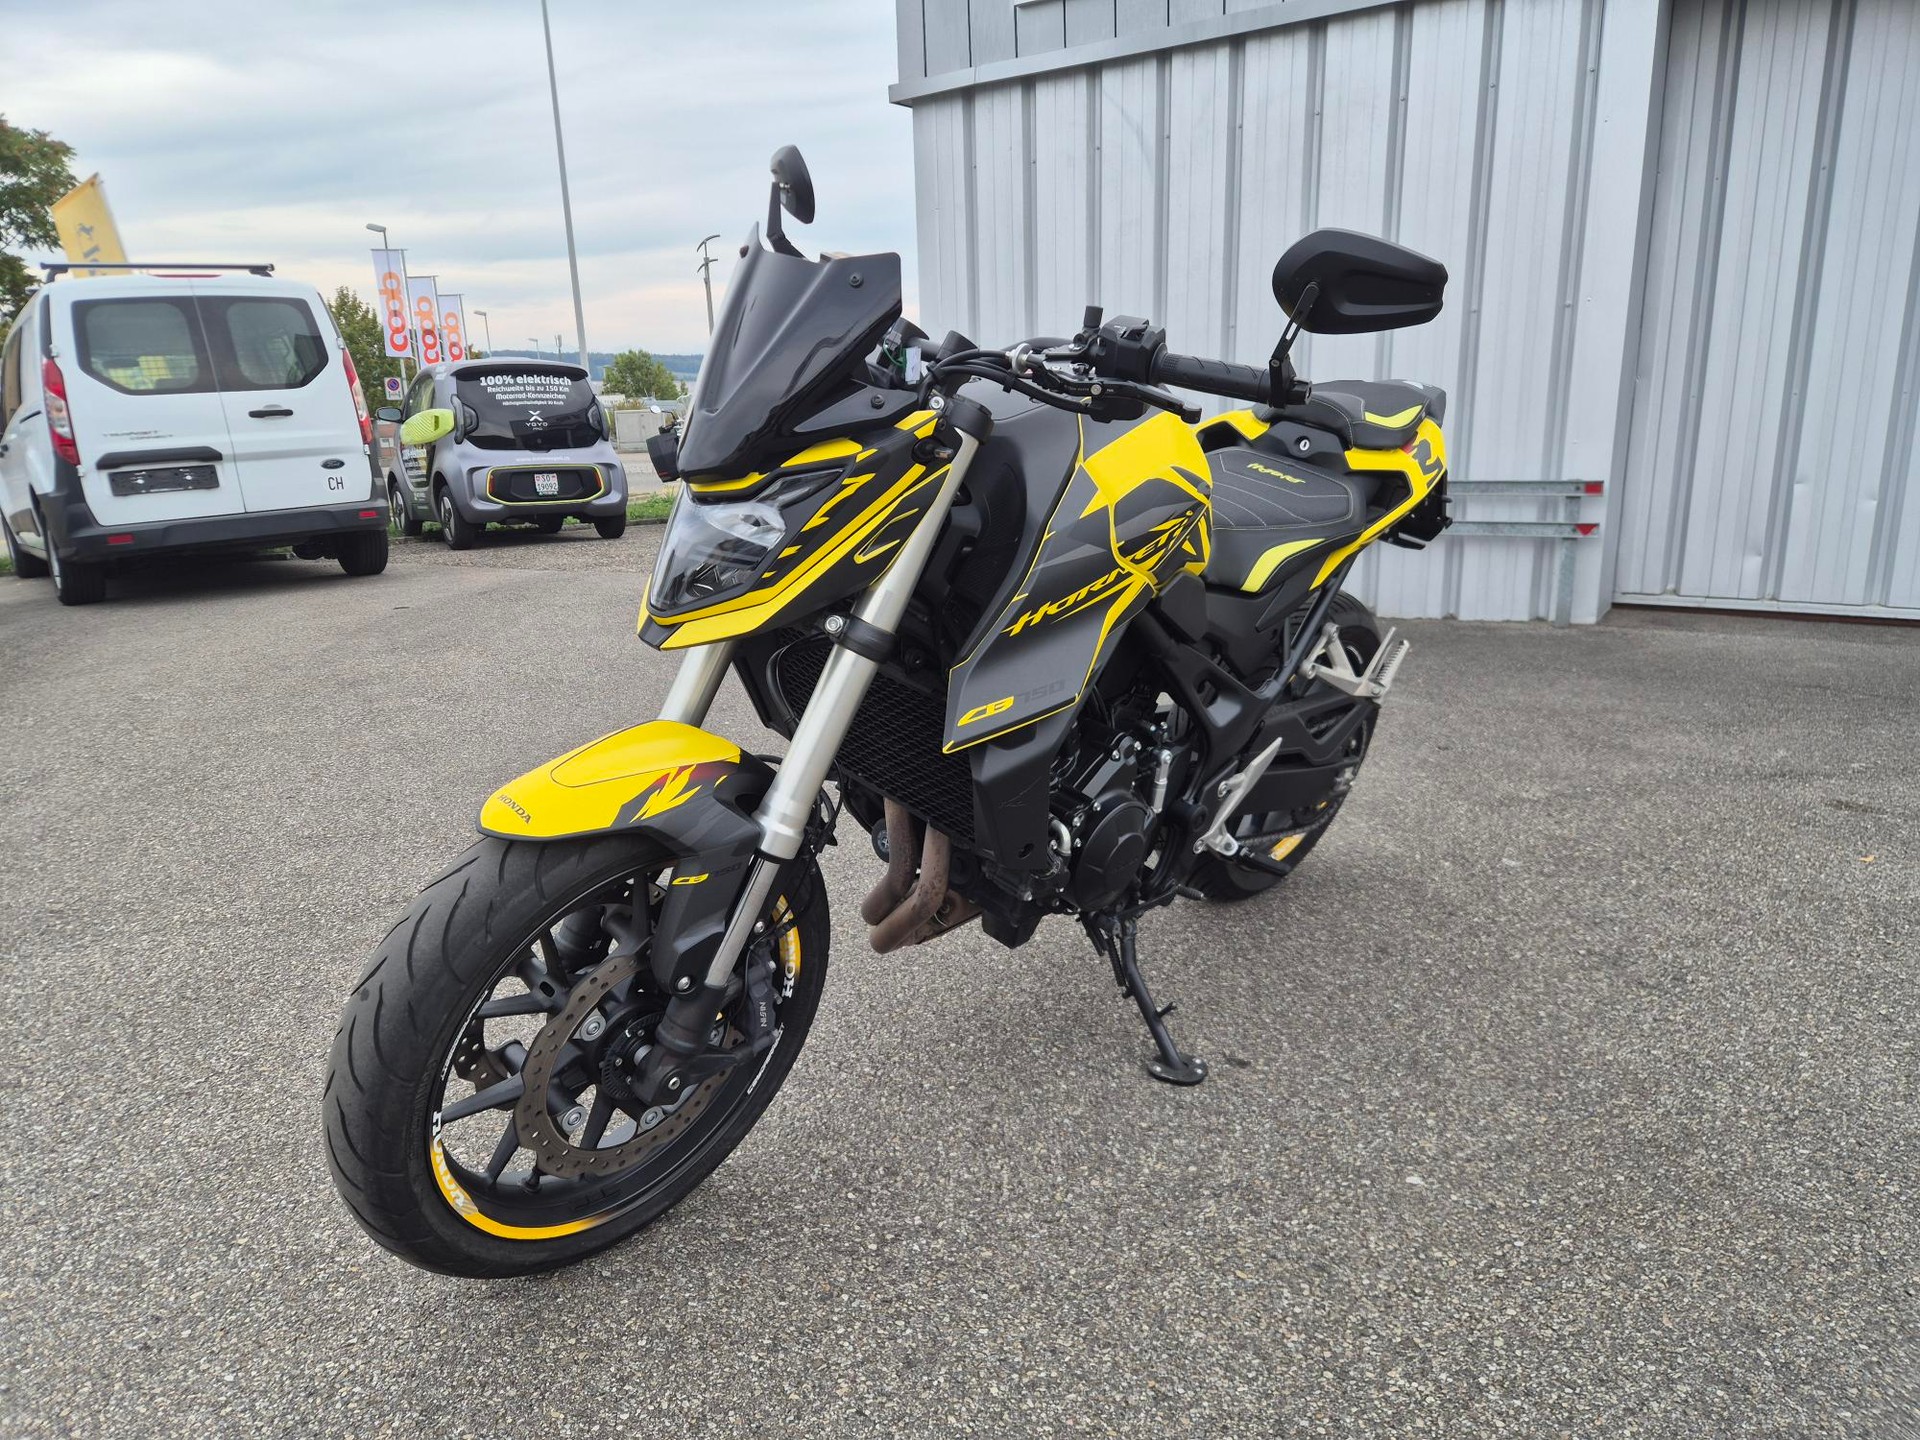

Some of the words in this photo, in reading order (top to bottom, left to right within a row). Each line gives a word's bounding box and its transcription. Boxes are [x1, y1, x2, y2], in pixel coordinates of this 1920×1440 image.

[379, 271, 410, 352] coop
[414, 295, 441, 364] coop
[441, 312, 464, 362] oop
[480, 375, 514, 386] 100%
[516, 374, 572, 386] elektrisch
[487, 385, 525, 393] Reichweite
[327, 476, 345, 490] CH
[541, 474, 551, 482] SO
[497, 794, 532, 824] HONDA
